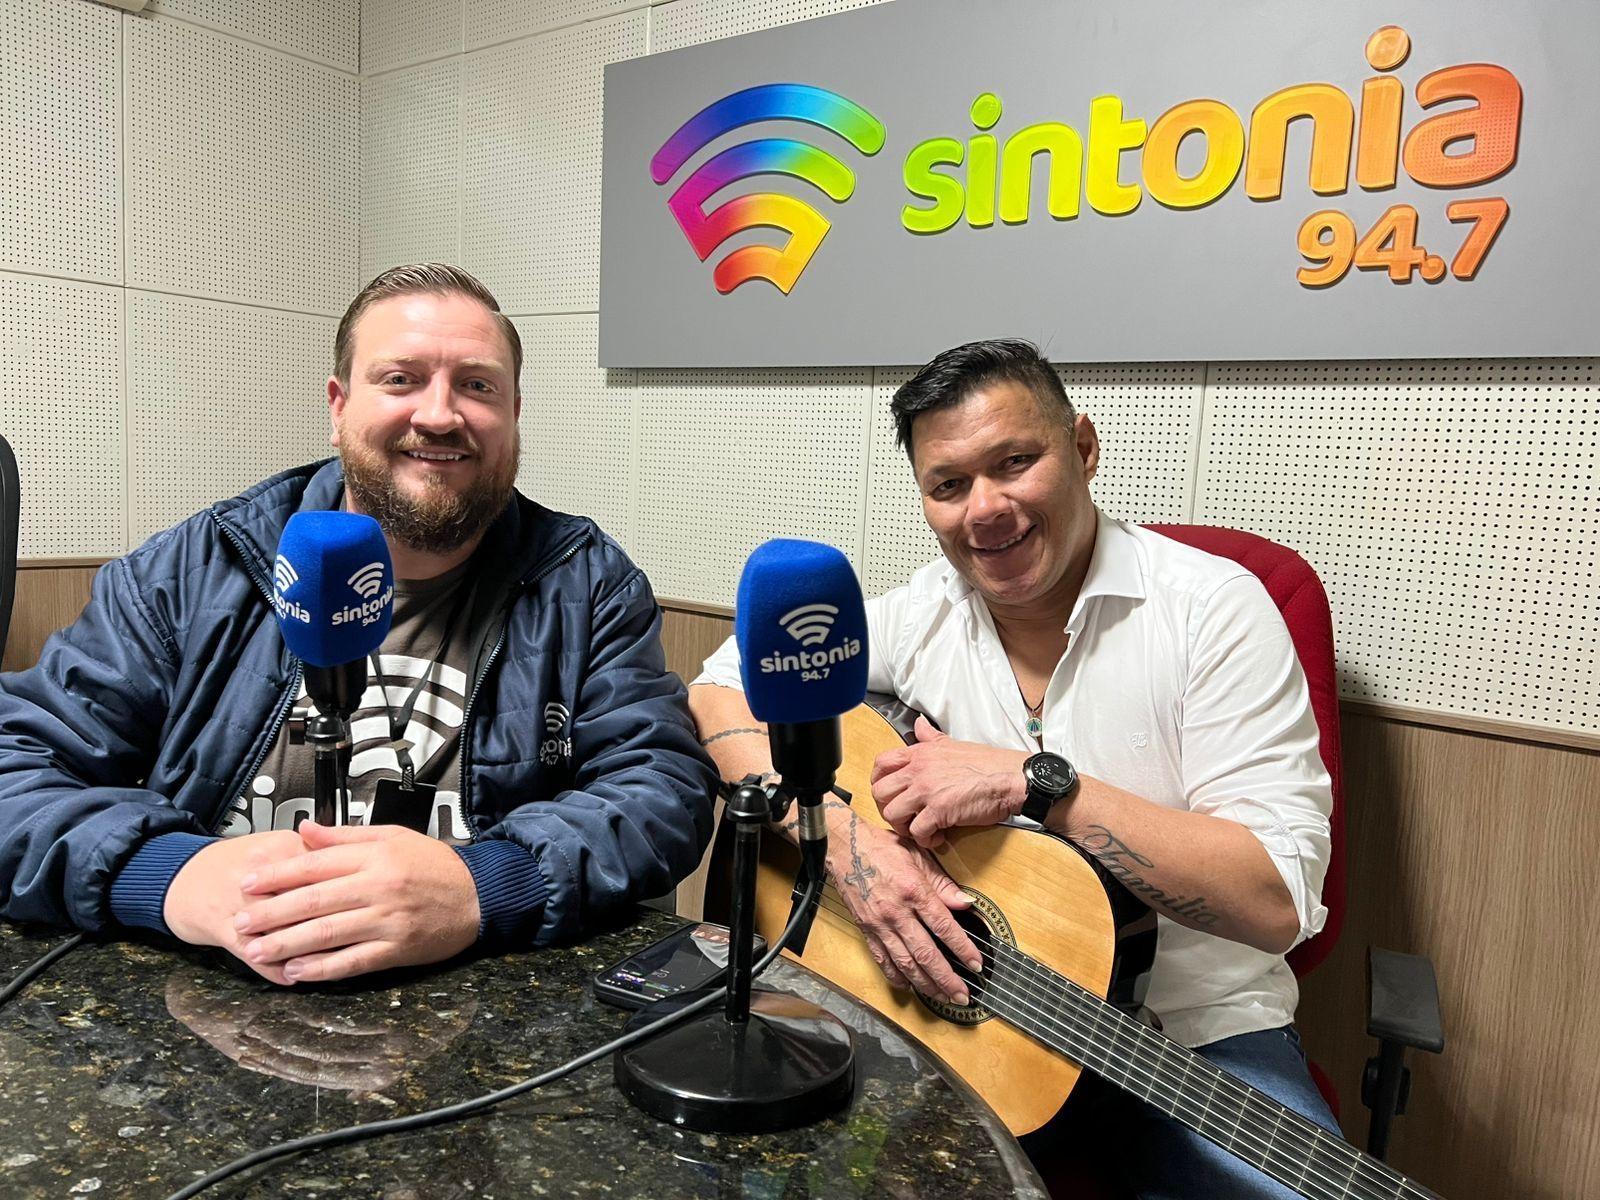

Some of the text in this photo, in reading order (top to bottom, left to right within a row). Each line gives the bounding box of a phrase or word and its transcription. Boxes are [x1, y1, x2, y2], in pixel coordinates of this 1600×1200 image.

[900, 25, 1523, 235] sintonia
[1295, 197, 1511, 287] 94.7
[760, 637, 861, 673] sintonia
[801, 667, 831, 682] 94.7
